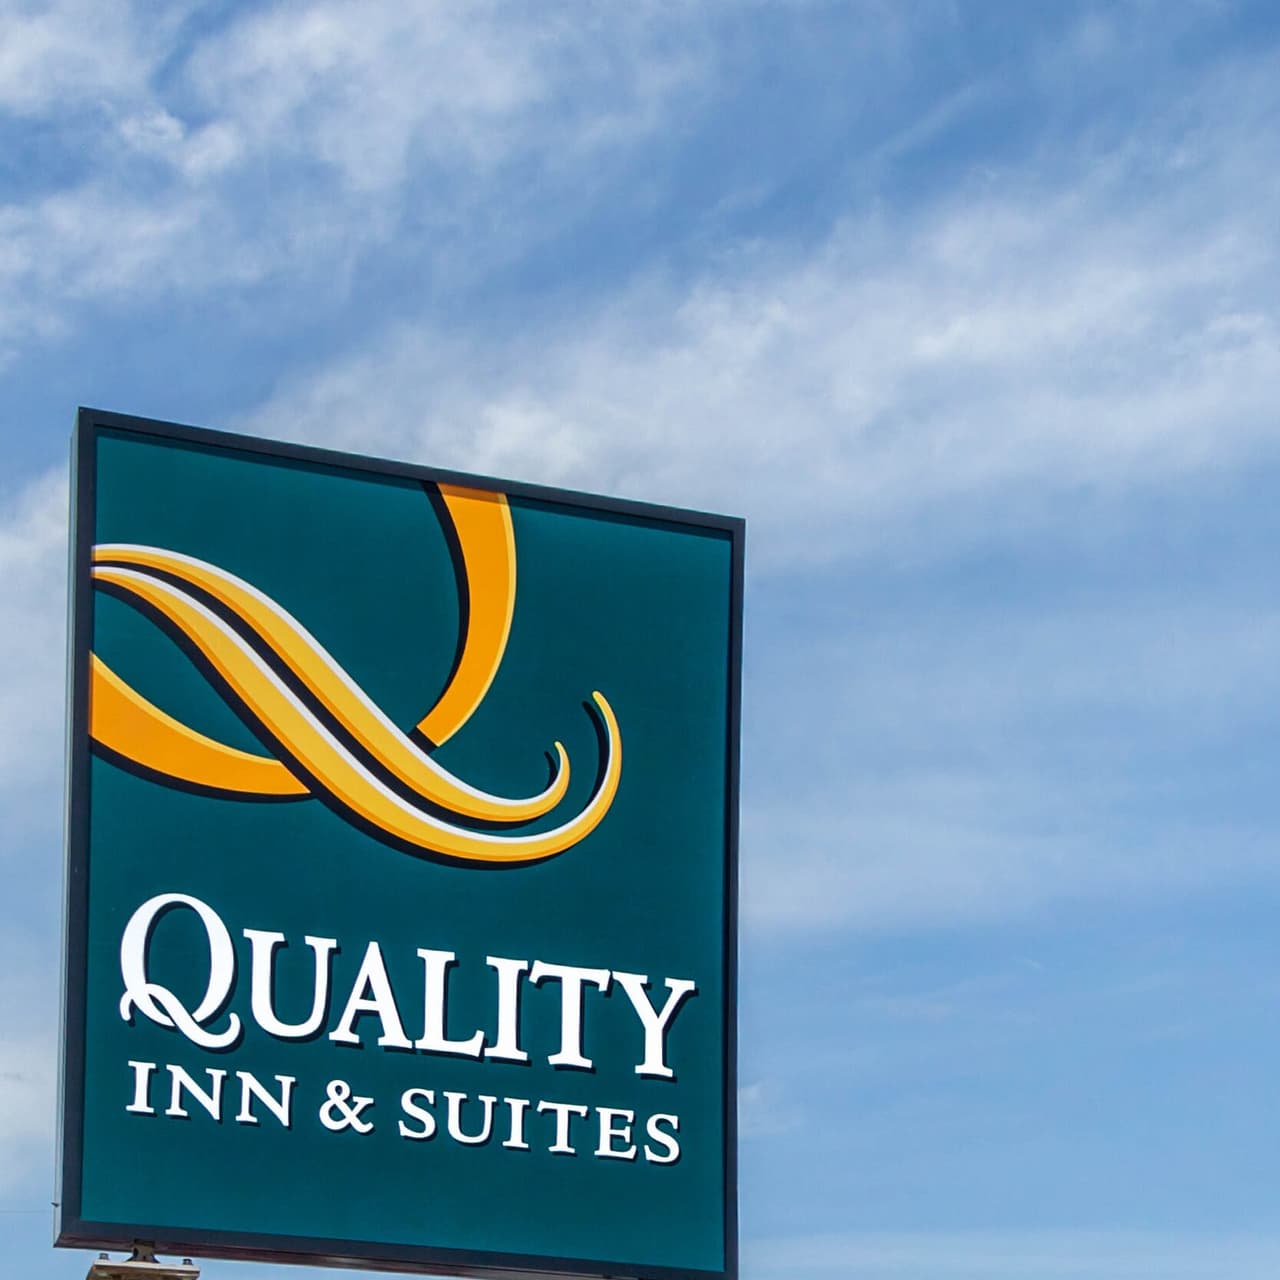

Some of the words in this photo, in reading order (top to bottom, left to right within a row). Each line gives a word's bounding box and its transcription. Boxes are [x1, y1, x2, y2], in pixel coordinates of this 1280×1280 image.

[119, 892, 697, 1080] QUALITY
[125, 1060, 296, 1130] INN
[318, 1078, 374, 1135] &
[397, 1087, 682, 1165] SUITES
